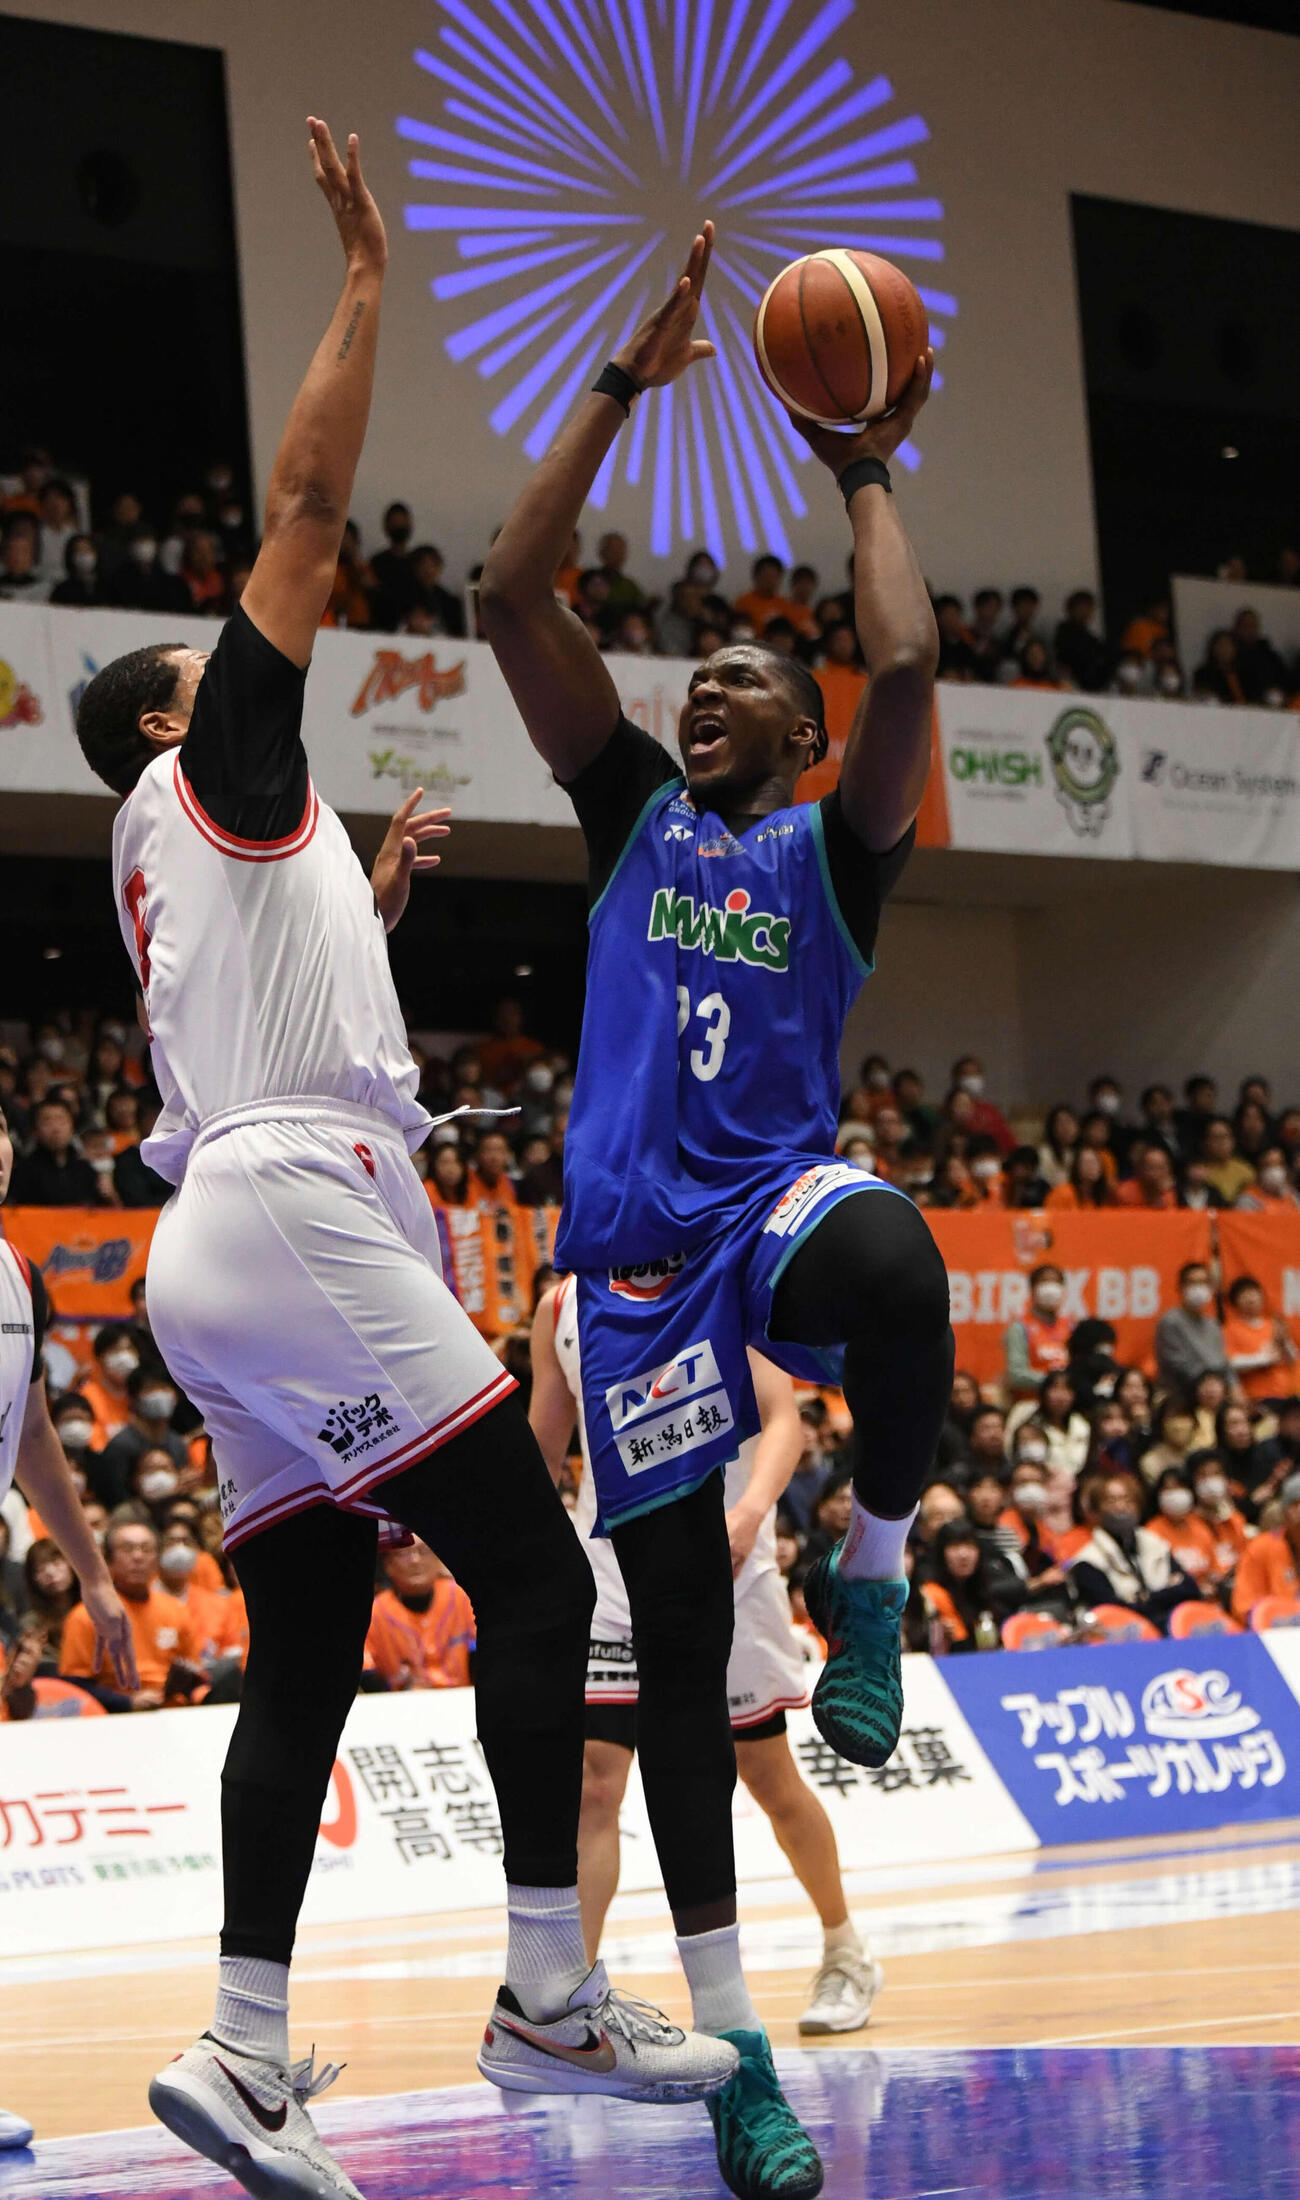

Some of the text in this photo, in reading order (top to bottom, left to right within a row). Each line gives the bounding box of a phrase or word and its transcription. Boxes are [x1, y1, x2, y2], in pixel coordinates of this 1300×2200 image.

[1096, 1266, 1161, 1319] BB
[335, 1392, 382, 1430] パック
[621, 1352, 704, 1417] NCT
[355, 1407, 394, 1437] デポ
[627, 1404, 729, 1467] 新潟日報
[1000, 1685, 1136, 1749] アップル
